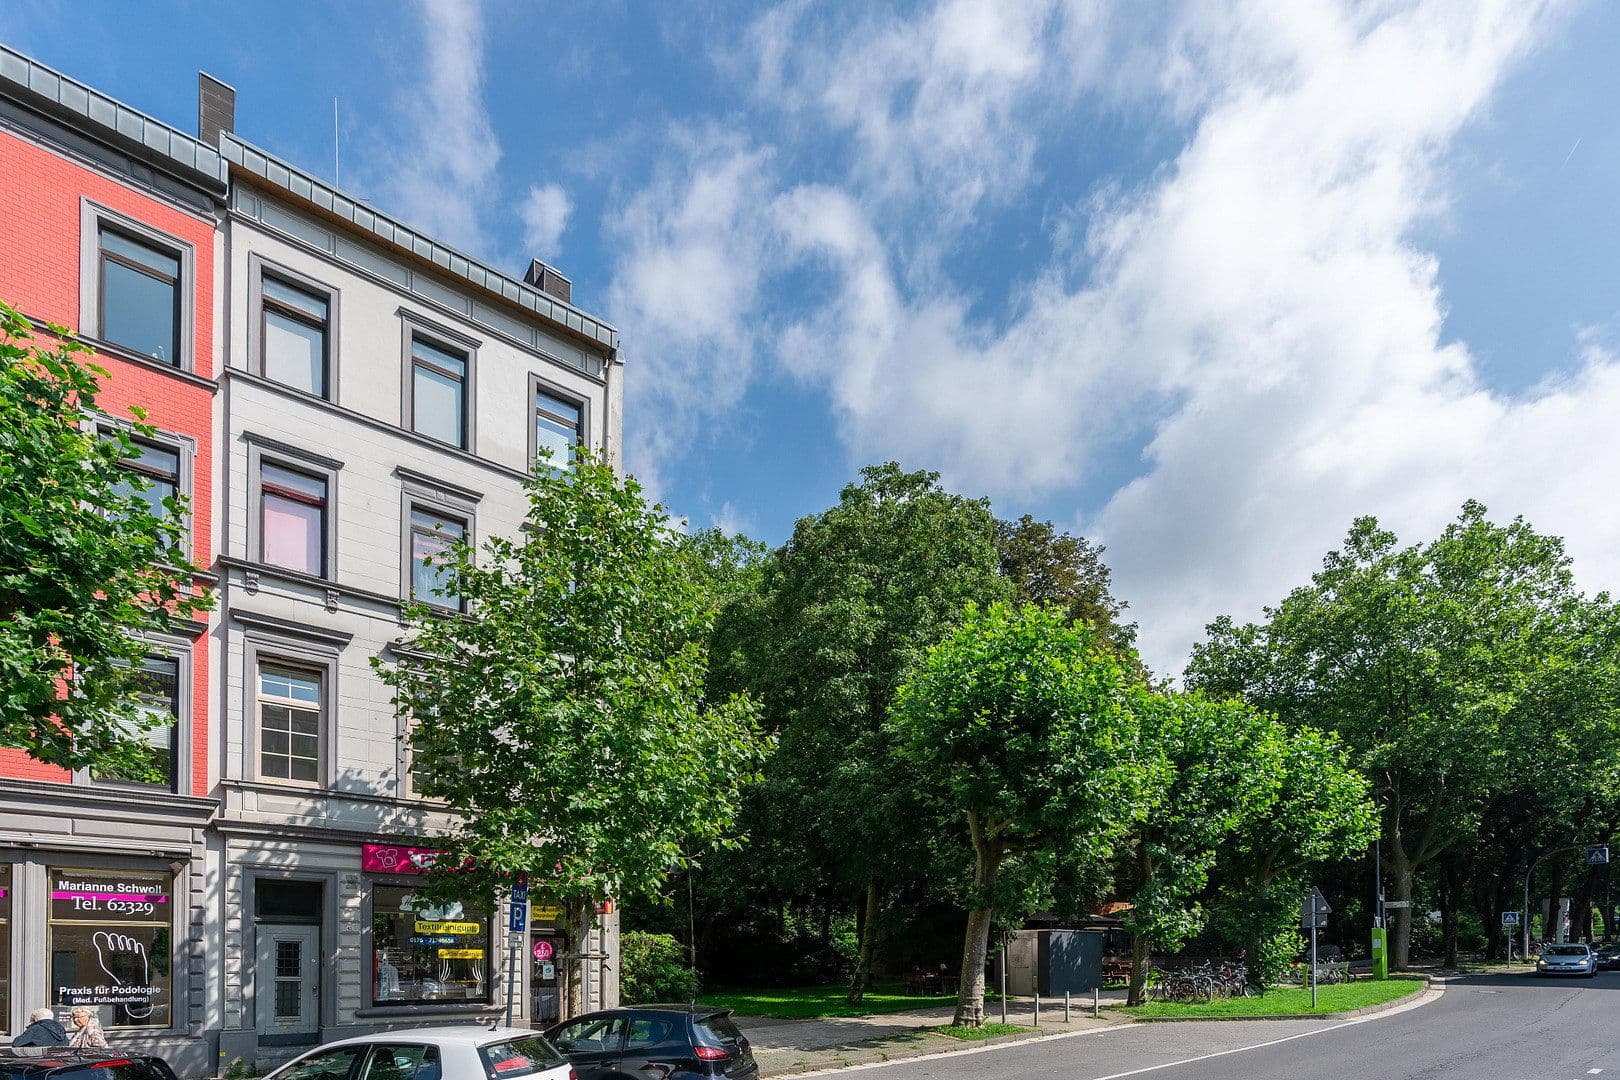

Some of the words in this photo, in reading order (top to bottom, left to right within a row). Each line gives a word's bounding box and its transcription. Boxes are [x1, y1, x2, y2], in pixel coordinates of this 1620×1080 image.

[59, 880, 114, 892] Marianne
[513, 889, 526, 898] TAXI
[71, 895, 101, 911] Tel.
[107, 897, 154, 916] 62329
[513, 907, 523, 928] P
[59, 986, 92, 996] Praxis
[94, 985, 110, 995] für
[112, 985, 161, 997] Podologie
[72, 996, 93, 1005] (Med.
[94, 995, 150, 1004] Fußbehandlung)
